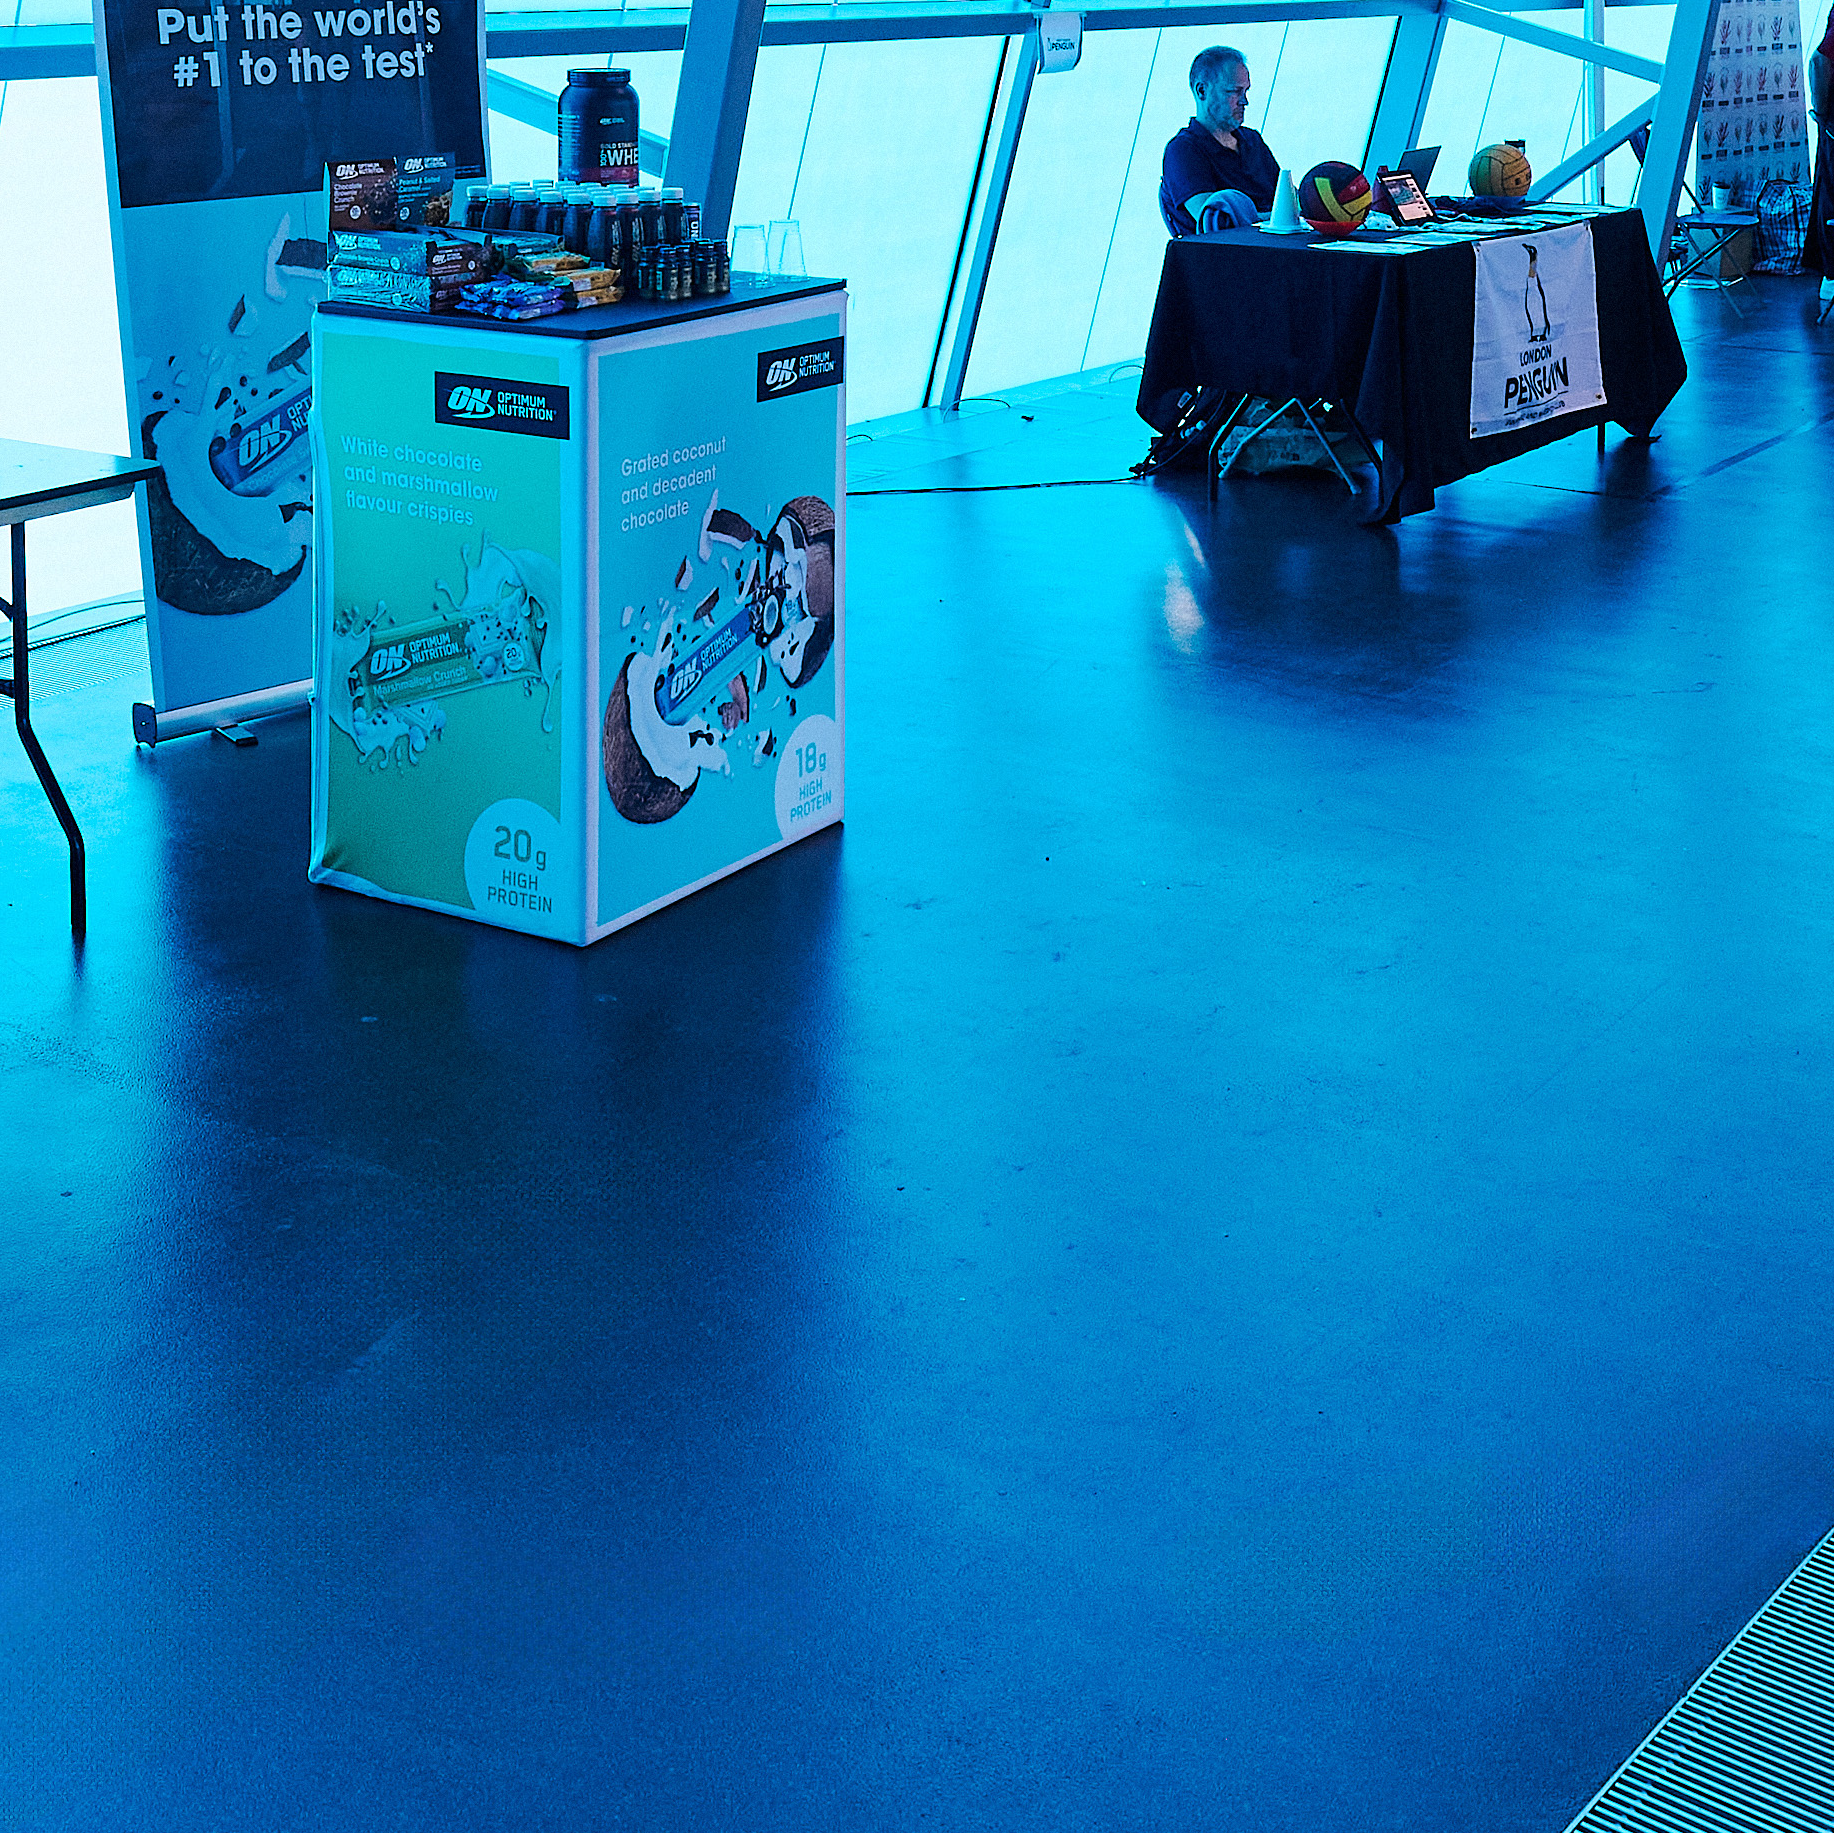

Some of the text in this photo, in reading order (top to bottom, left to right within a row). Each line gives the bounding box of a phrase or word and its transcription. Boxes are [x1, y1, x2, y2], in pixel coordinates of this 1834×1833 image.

[157, 6, 229, 45] Put
[241, 4, 303, 40] the
[173, 50, 221, 87] #1
[239, 49, 277, 85] to
[288, 47, 350, 83] the
[798, 360, 835, 378] NUTRITION
[799, 350, 831, 367] OPTIMUM
[1519, 344, 1552, 367] LONDON
[766, 357, 798, 392] ON
[1504, 356, 1569, 409] PENGUIN
[286, 394, 313, 421] OPTI
[447, 385, 496, 419] ON
[497, 391, 546, 409] OPTIMUM
[497, 403, 555, 422] NUTRITION
[238, 413, 293, 473] ON
[340, 434, 389, 458] White
[393, 444, 483, 473] chocolate
[621, 435, 726, 477] Grated coconut
[344, 465, 499, 502] and marshmallow
[621, 464, 717, 505] and decadent
[345, 489, 474, 526] flavour crispies
[621, 499, 689, 532] chocolate
[409, 631, 451, 654] OPTIMUM
[411, 642, 461, 665] NUTRITION
[700, 627, 733, 662] OPTIMUM
[702, 632, 738, 672] NUTRITION
[370, 643, 412, 682] ON
[670, 656, 703, 702] ON
[372, 665, 468, 697] Marshmallow Crunch
[795, 742, 827, 778] 18g
[790, 789, 832, 822] PROTEIN
[799, 776, 823, 801] HIGH
[494, 825, 547, 872] 20g
[502, 868, 538, 892] HIGH
[487, 885, 552, 914] PROTEIN
